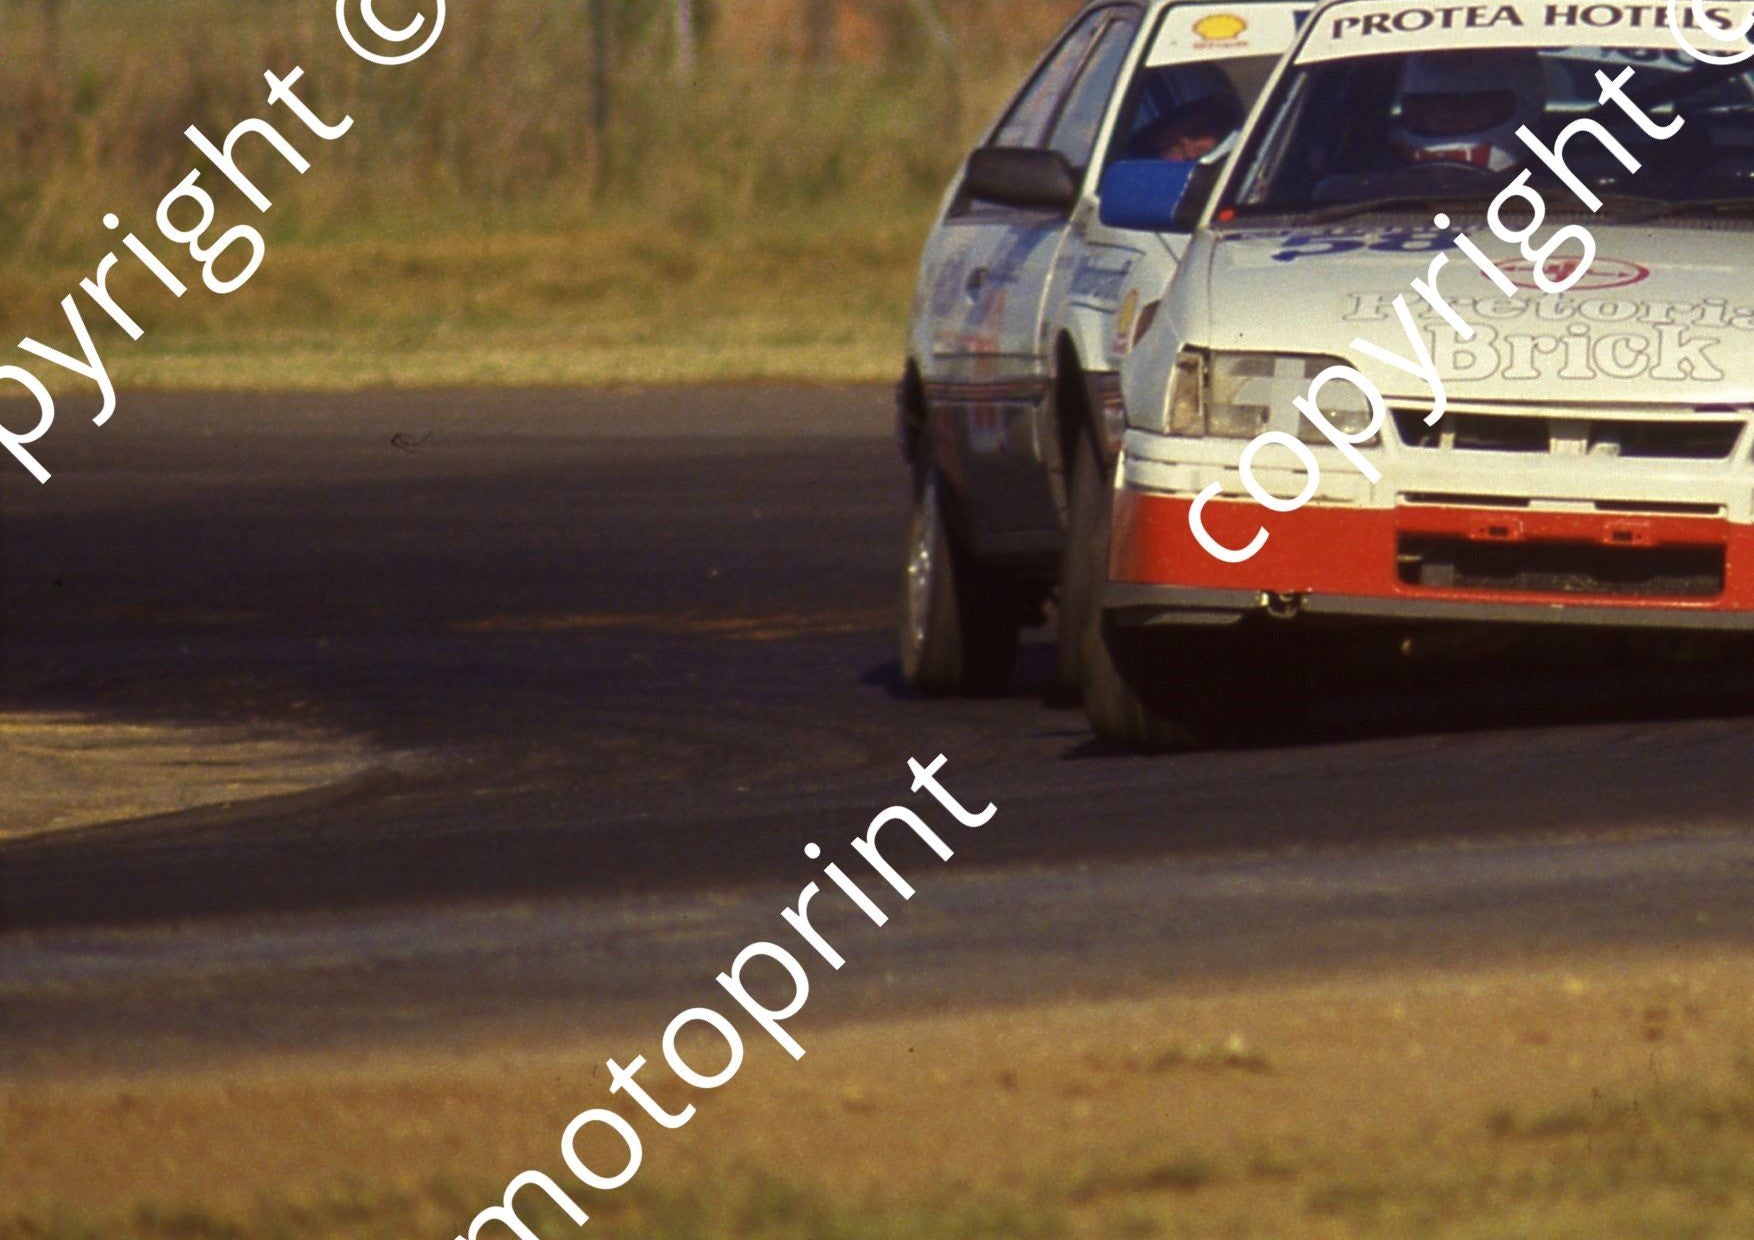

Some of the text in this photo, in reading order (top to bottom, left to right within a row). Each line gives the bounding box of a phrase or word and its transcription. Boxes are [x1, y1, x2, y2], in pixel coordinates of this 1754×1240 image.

[1331, 4, 1524, 41] PROTEA
[1543, 3, 1733, 31] HOTELS
[1420, 321, 1725, 383] Brick
